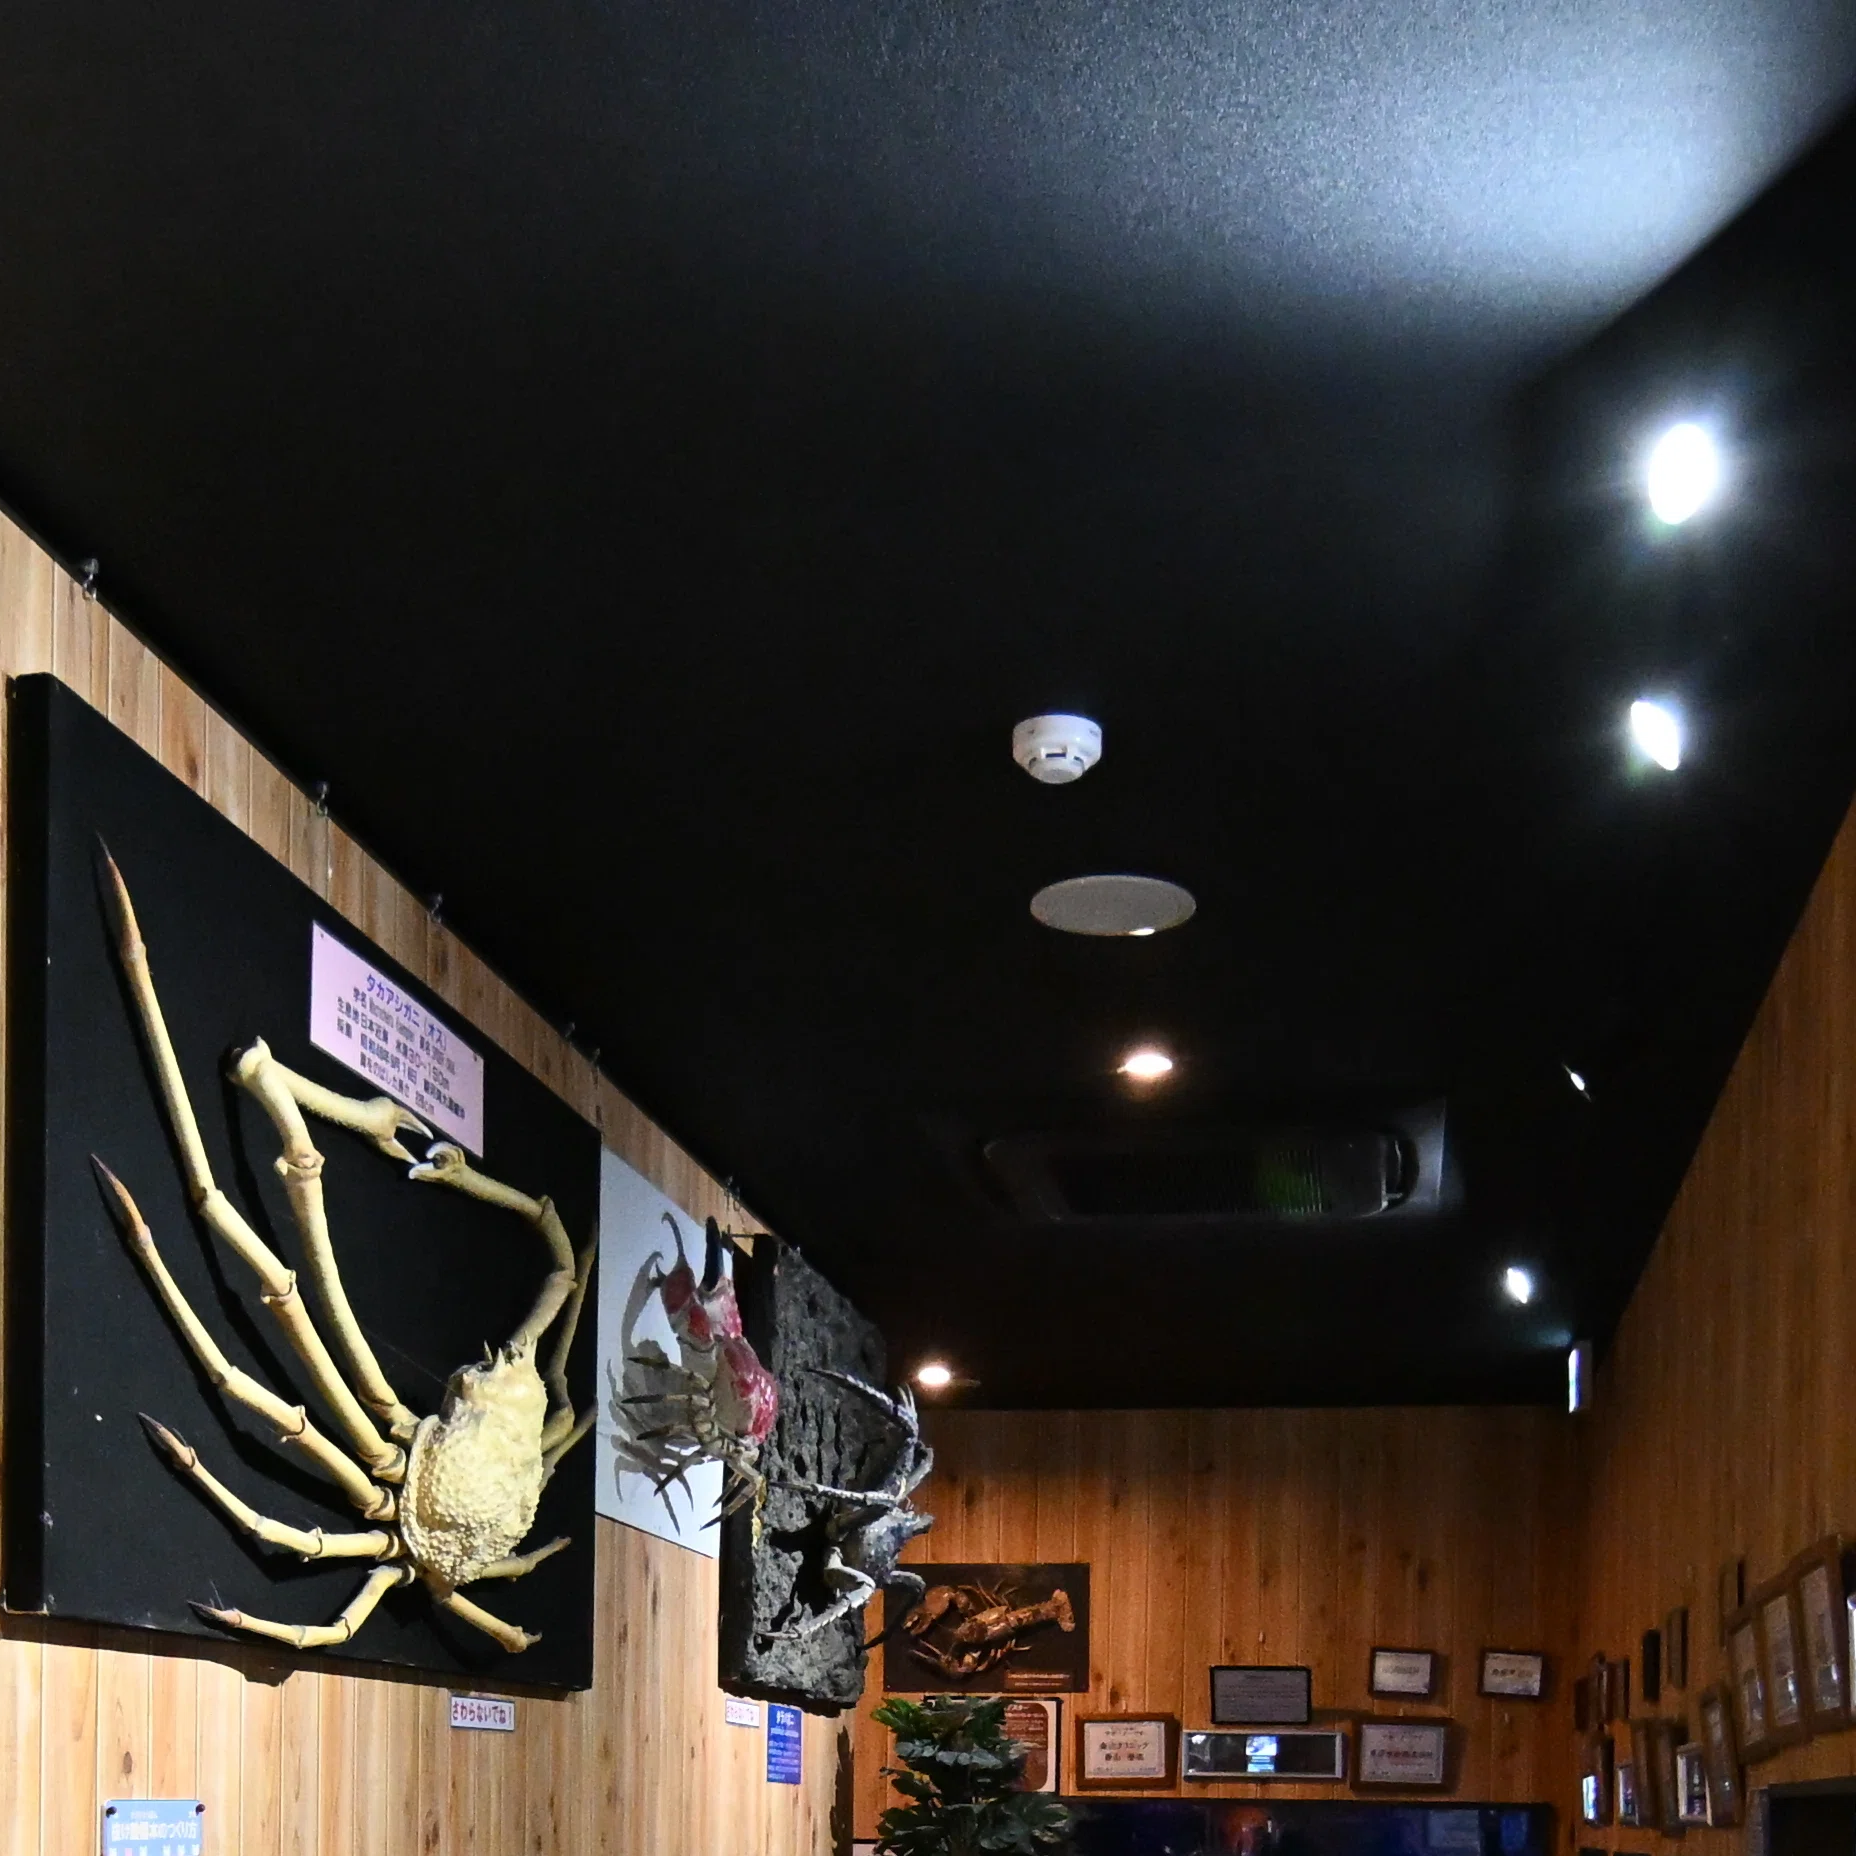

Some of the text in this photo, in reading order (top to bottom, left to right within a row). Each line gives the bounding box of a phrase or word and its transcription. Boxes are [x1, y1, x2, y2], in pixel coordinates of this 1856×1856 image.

[452, 1700, 512, 1725] さわらないでね!
